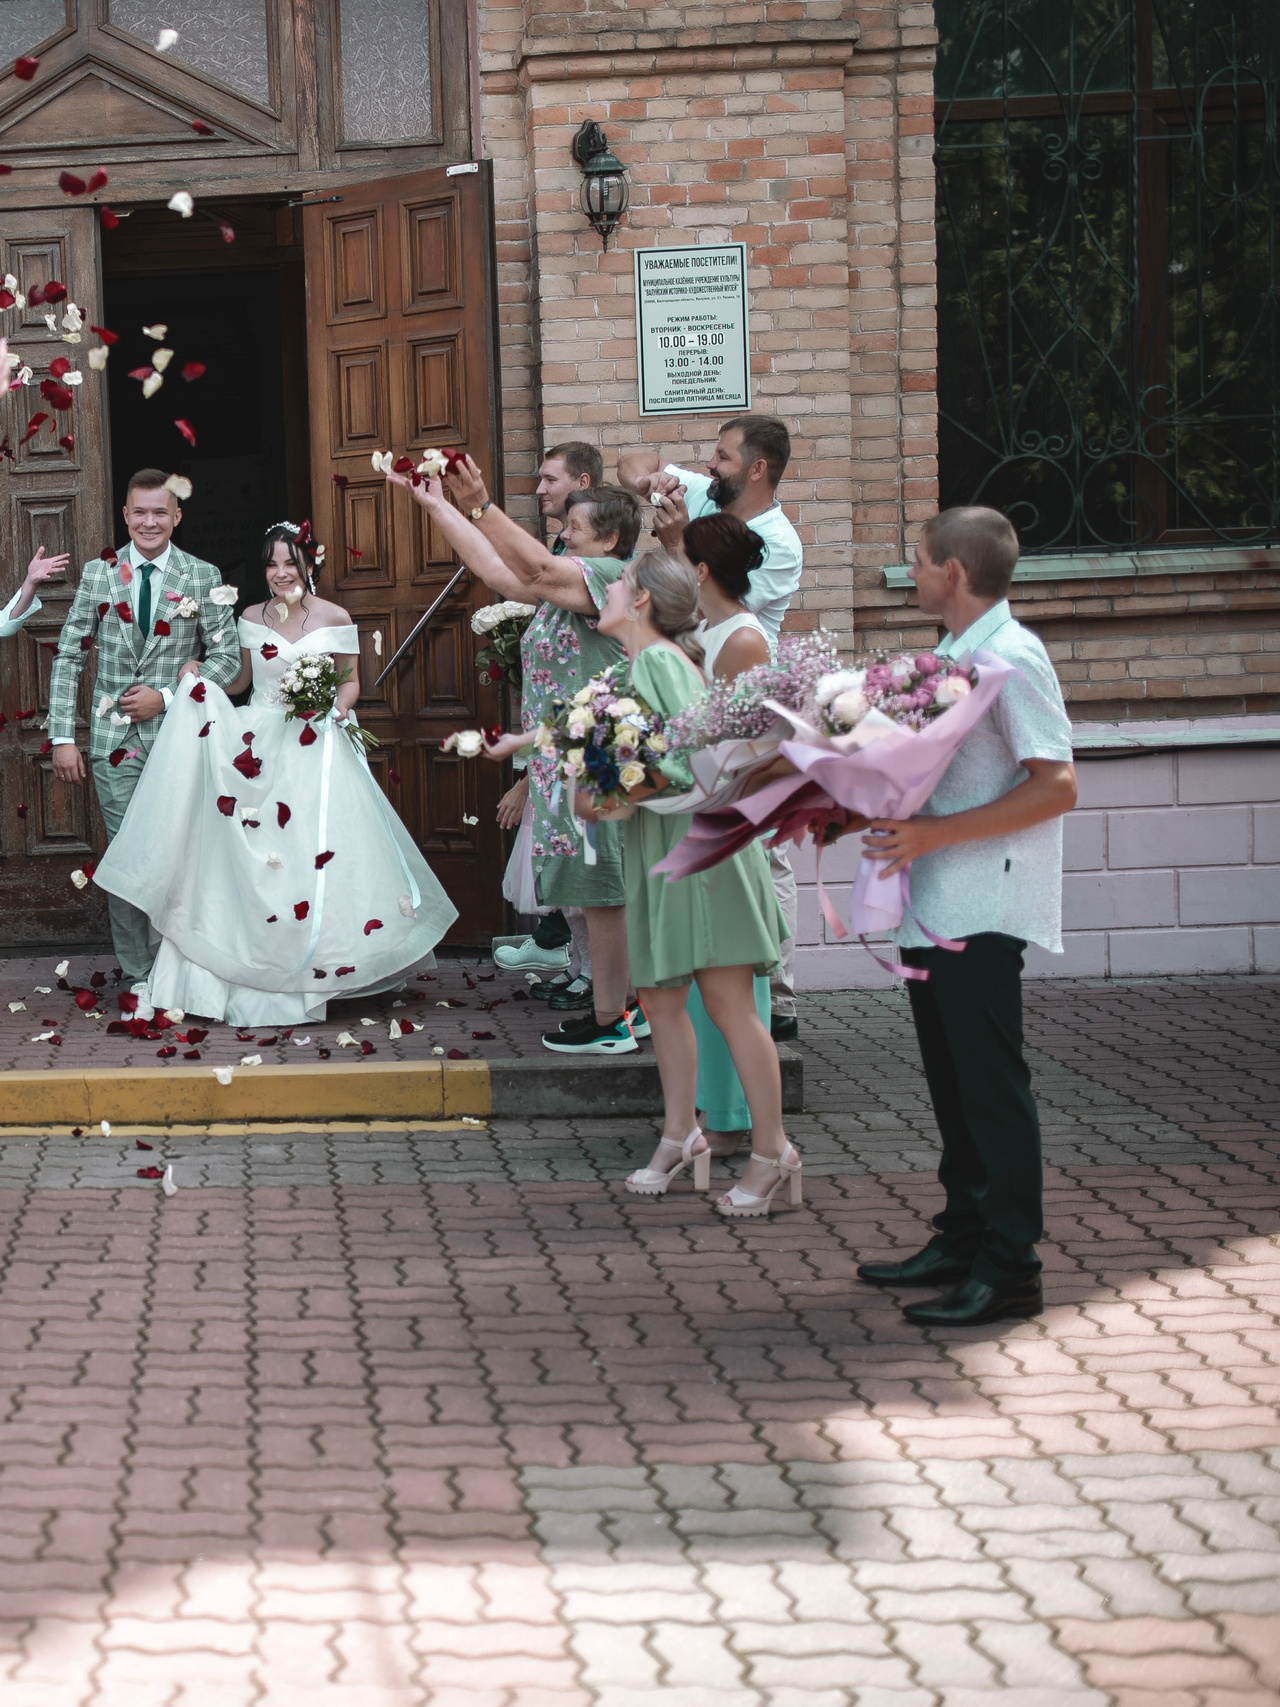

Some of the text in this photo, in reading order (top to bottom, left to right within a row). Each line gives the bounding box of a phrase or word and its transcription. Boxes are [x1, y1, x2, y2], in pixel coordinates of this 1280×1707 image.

[644, 255, 738, 270] УВАЖАЕМЫЕ ПОСЕТИТЕЛИ!
[643, 278, 675, 287] МУНИЦИПАЛЬНОЕ
[695, 275, 720, 284] УЧРЕЖДЕНИЕ
[720, 274, 740, 282] КУЛЬТУРЫ
[688, 323, 735, 332] ВОСКРЕСЕНЬЕ
[659, 335, 686, 348] 10.00
[697, 333, 724, 346] 19.00
[664, 357, 689, 368] 13.00
[698, 355, 724, 366] 14.00
[667, 370, 702, 378] ВЫХОДНОЙ
[671, 377, 717, 385] ПОНЕДЕЛЬНИК
[664, 387, 706, 396] САНИТАРНЫЙ
[648, 396, 685, 404] ПОСЛЕДНЯЯ
[686, 394, 715, 402] ПЯТНИЦА
